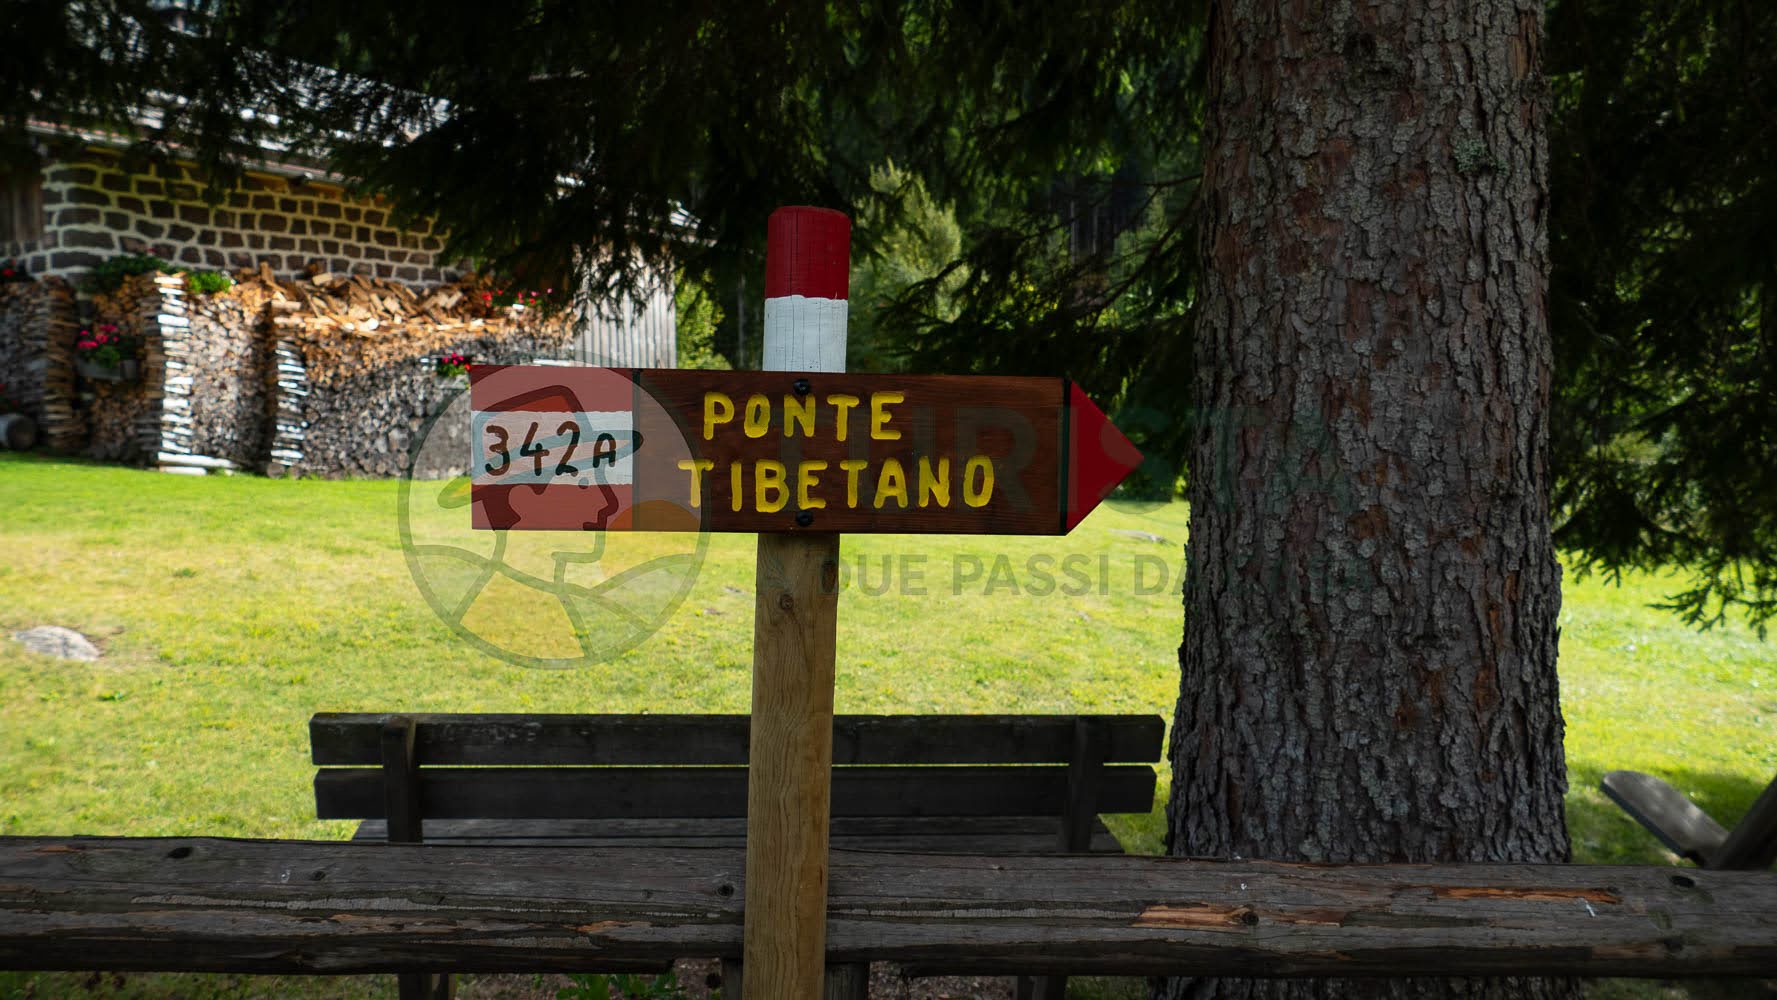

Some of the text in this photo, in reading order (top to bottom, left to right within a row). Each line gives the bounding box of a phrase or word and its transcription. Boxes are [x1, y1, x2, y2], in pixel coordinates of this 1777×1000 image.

[702, 391, 906, 441] PONTE
[484, 420, 617, 477] 342A
[677, 455, 997, 513] TIBETANO
